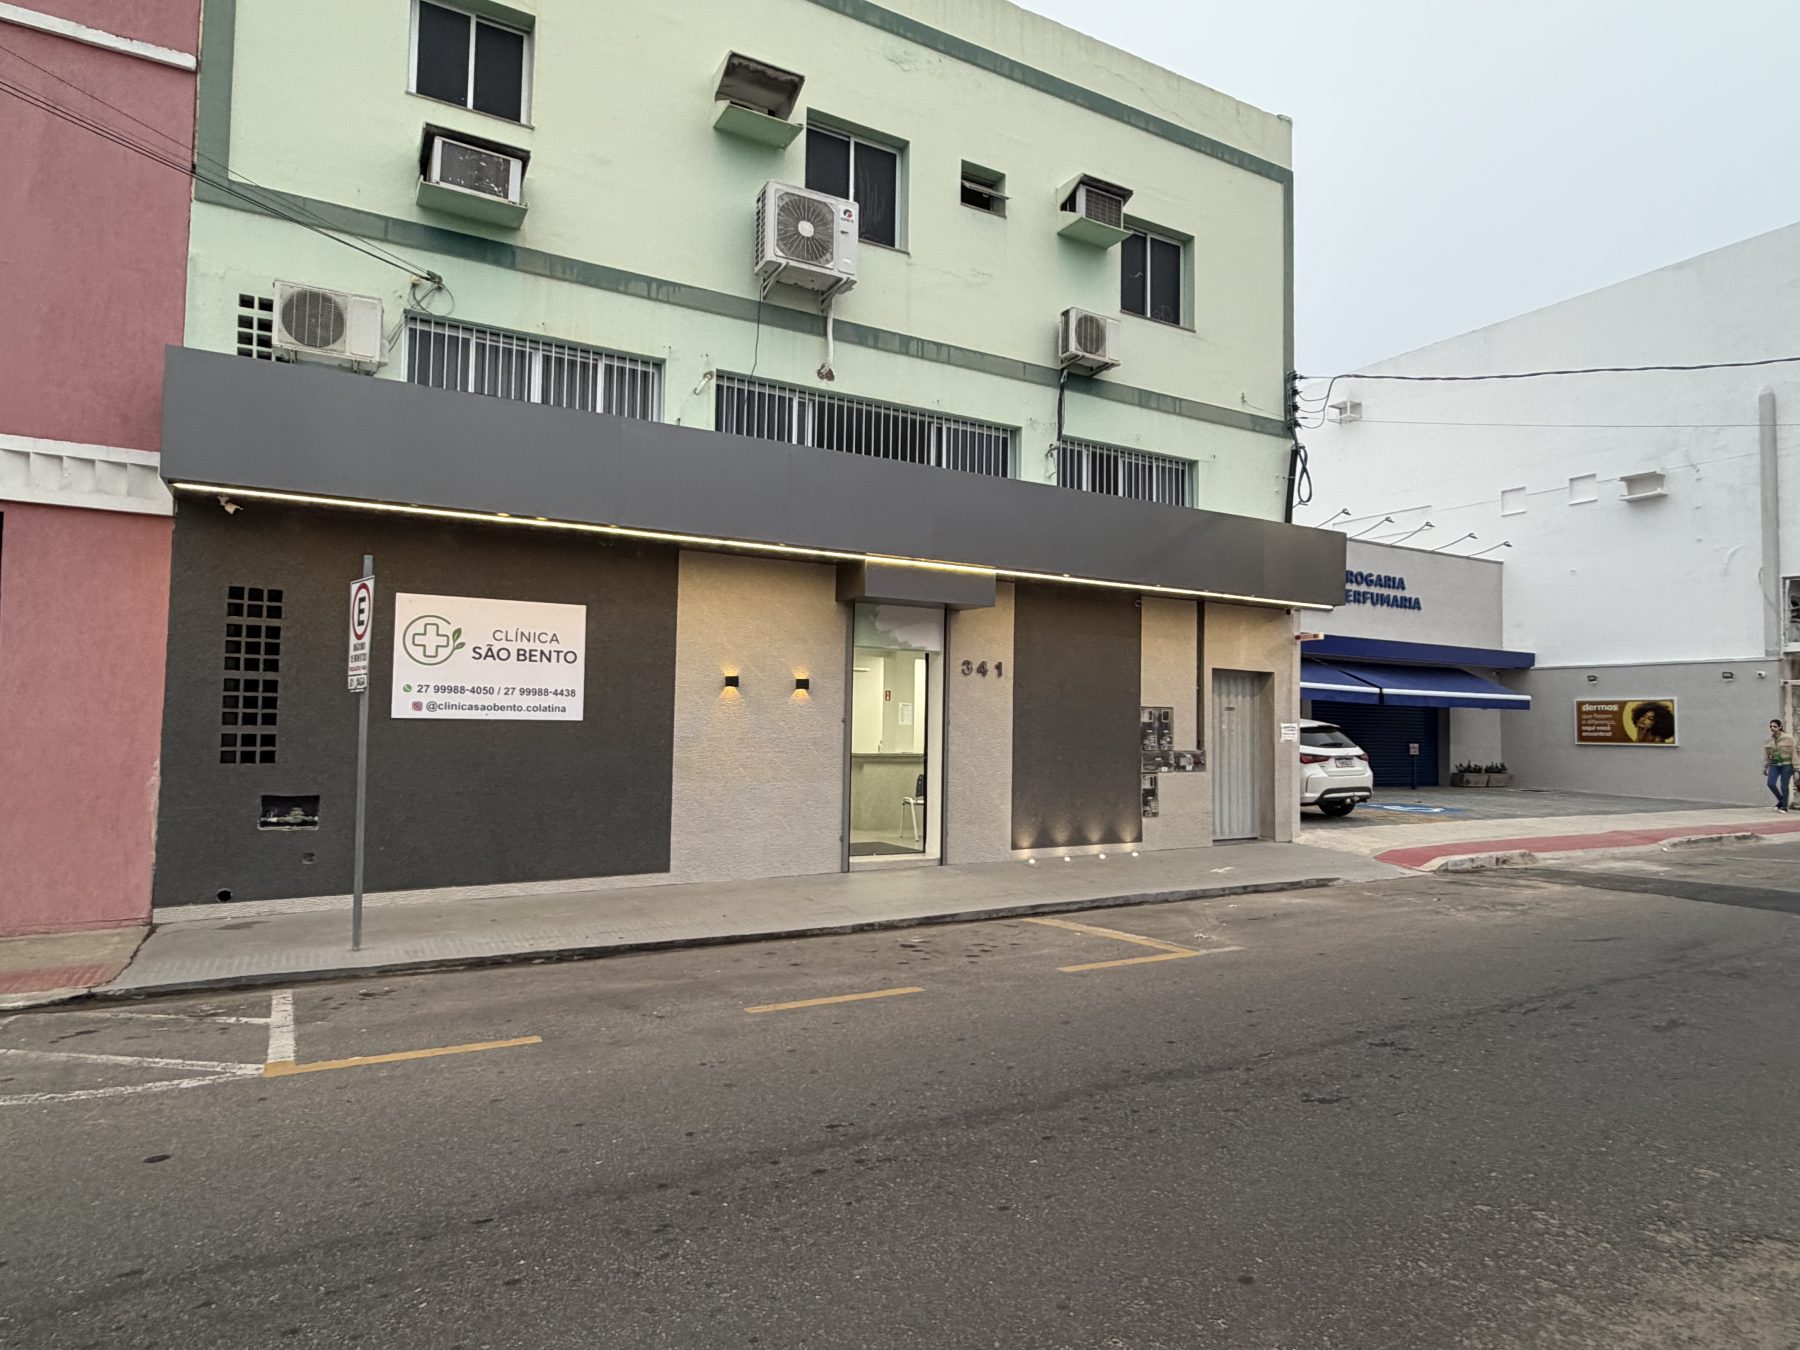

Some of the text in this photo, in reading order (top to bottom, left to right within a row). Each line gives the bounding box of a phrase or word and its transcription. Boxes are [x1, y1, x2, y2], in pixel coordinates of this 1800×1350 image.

[1346, 570, 1406, 590] ROGARIA
[1345, 589, 1421, 610] ERFUMARIA
[357, 596, 366, 626] E
[492, 628, 560, 644] CLÍNICA
[472, 644, 578, 664] SÃO BENTO
[960, 659, 1003, 678] 341
[417, 684, 430, 693] 27
[433, 684, 495, 695] 99988-4050
[503, 687, 516, 696] 27
[519, 687, 576, 698] 99988-4438
[425, 700, 567, 713] @clinicasaobento.colatina
